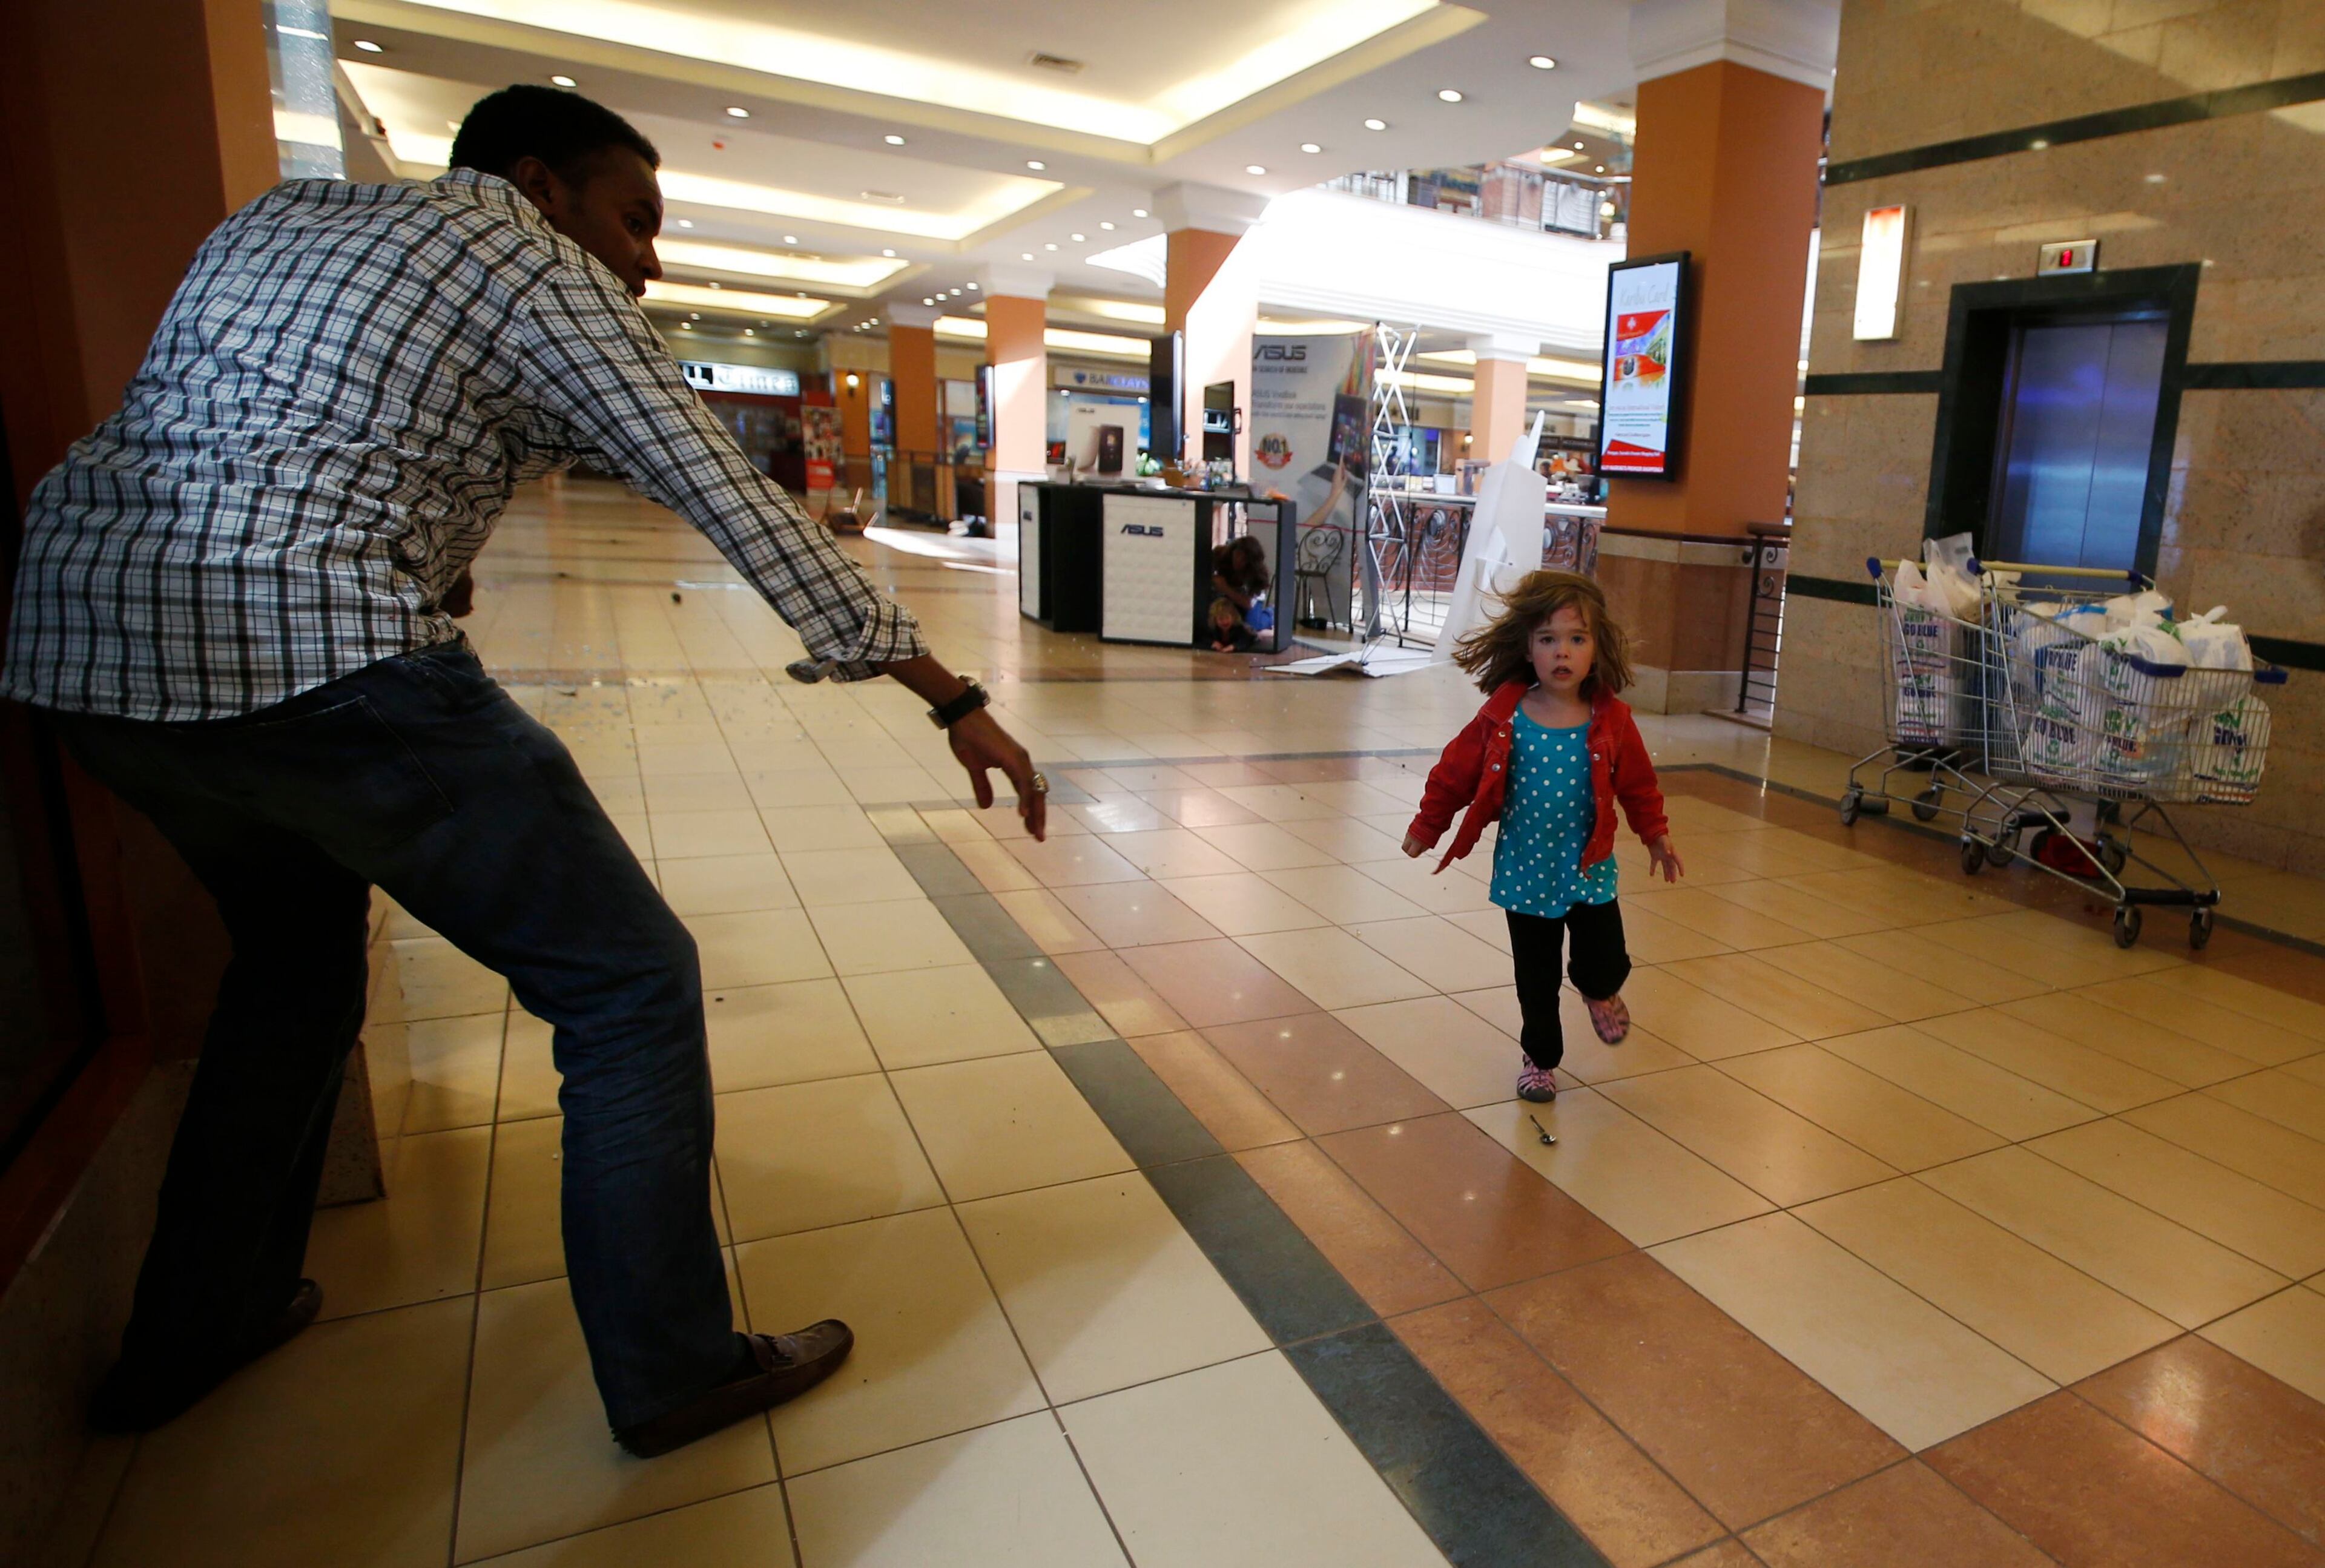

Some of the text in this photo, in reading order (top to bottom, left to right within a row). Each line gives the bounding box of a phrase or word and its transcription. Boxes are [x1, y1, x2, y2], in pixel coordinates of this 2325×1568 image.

[1254, 344, 1307, 360] ASUS
[1090, 373, 1149, 389] BARCLAYS
[1121, 524, 1164, 537] ASUS
